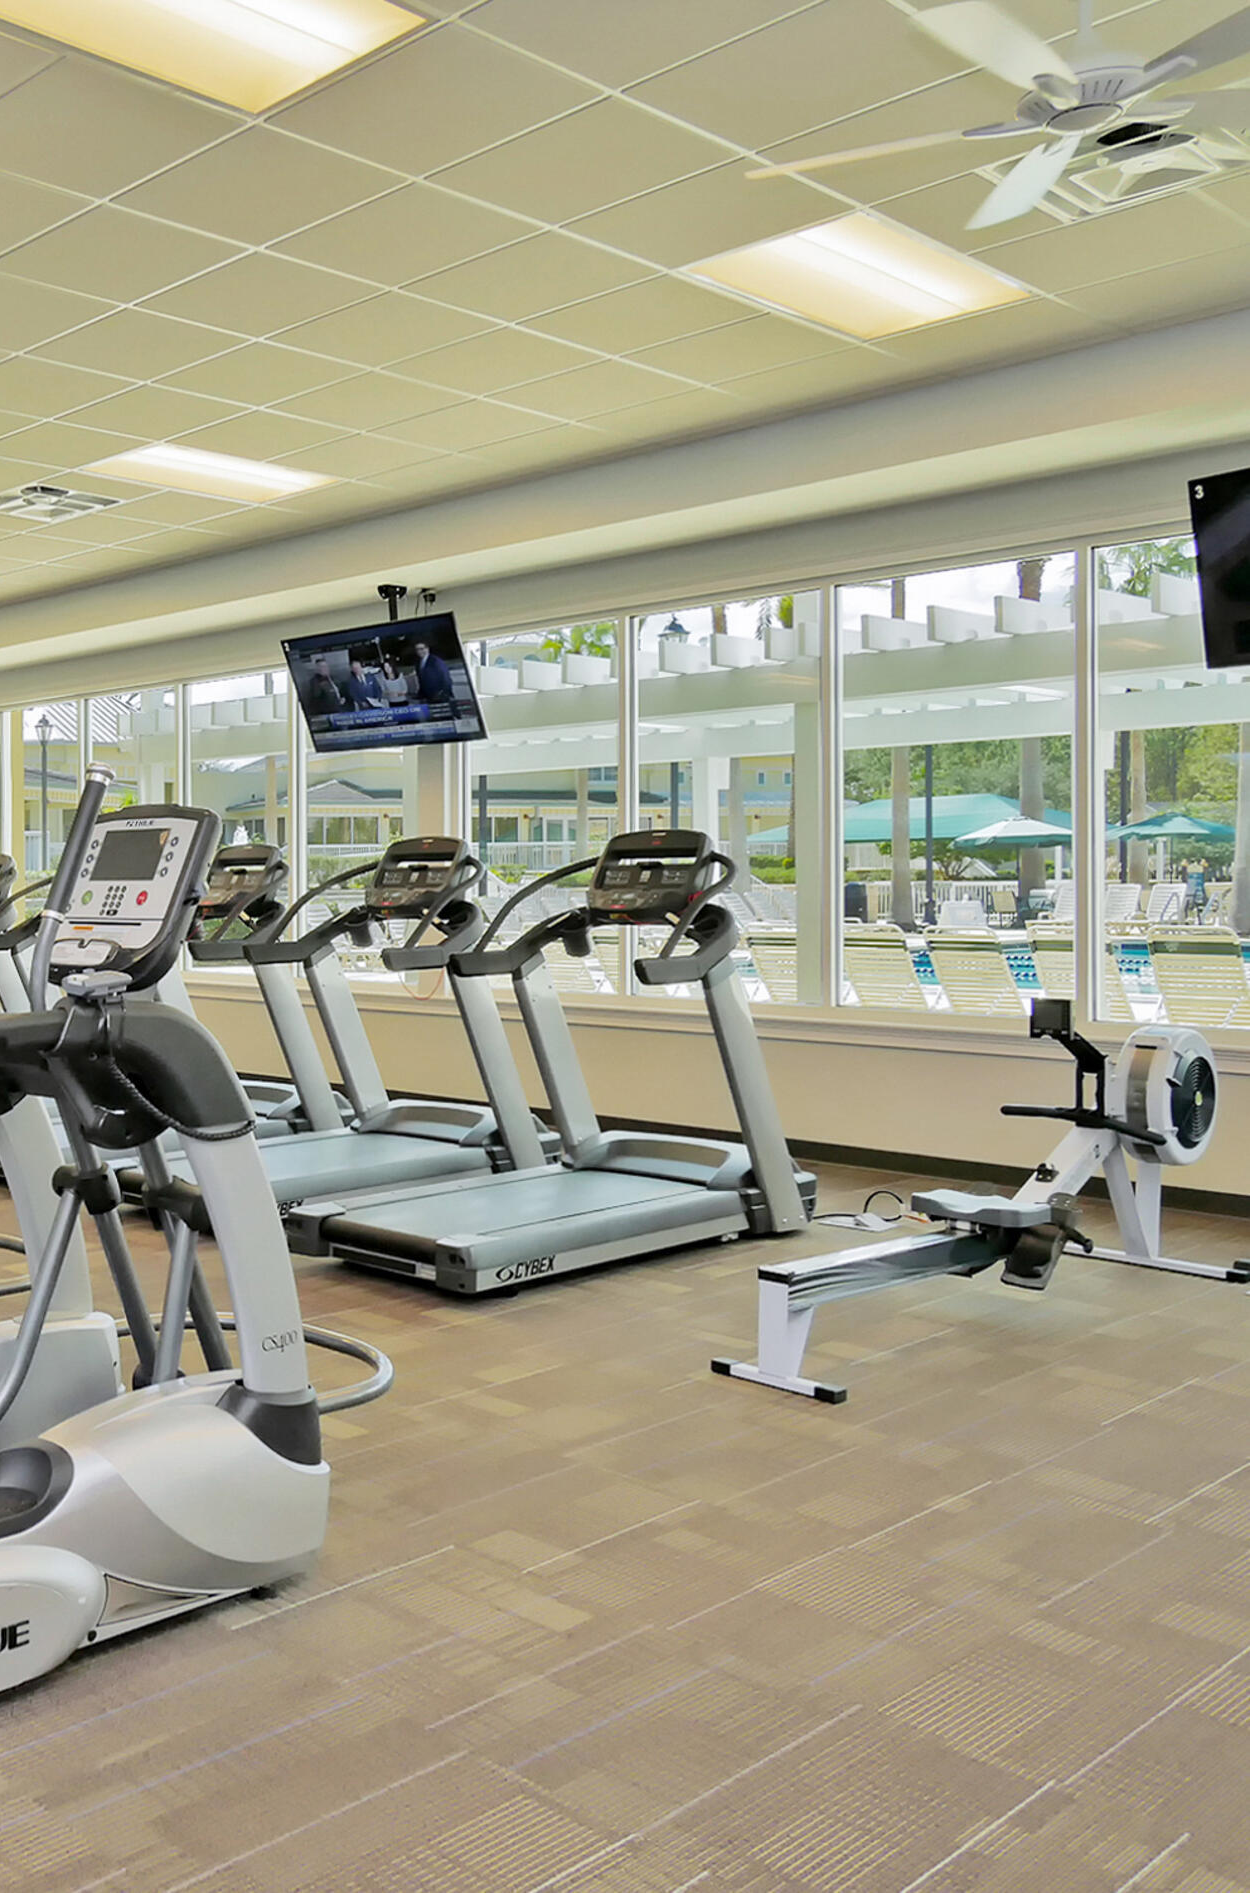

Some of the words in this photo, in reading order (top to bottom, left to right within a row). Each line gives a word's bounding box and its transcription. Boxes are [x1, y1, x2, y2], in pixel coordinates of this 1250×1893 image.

[1194, 485, 1204, 499] 3
[514, 1255, 556, 1279] CYBEX
[261, 1330, 298, 1352] CS400
